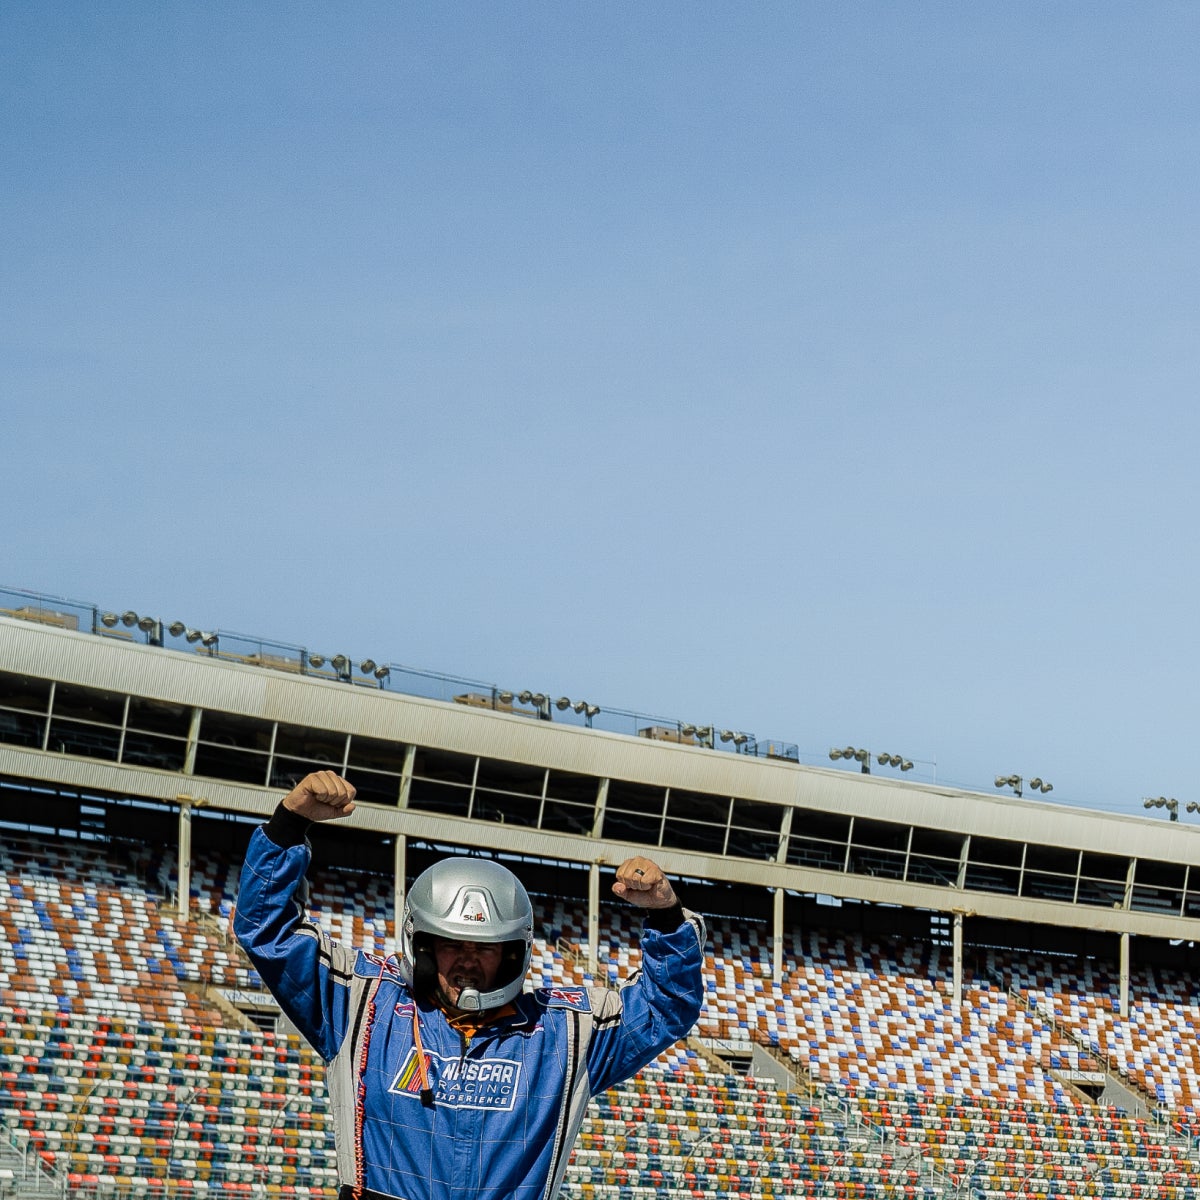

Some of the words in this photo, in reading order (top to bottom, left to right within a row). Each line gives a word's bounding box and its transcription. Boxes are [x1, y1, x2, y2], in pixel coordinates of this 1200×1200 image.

[441, 1062, 514, 1084] NASCAR
[438, 1080, 512, 1095] RACING
[435, 1092, 508, 1105] EXPERIENCE
